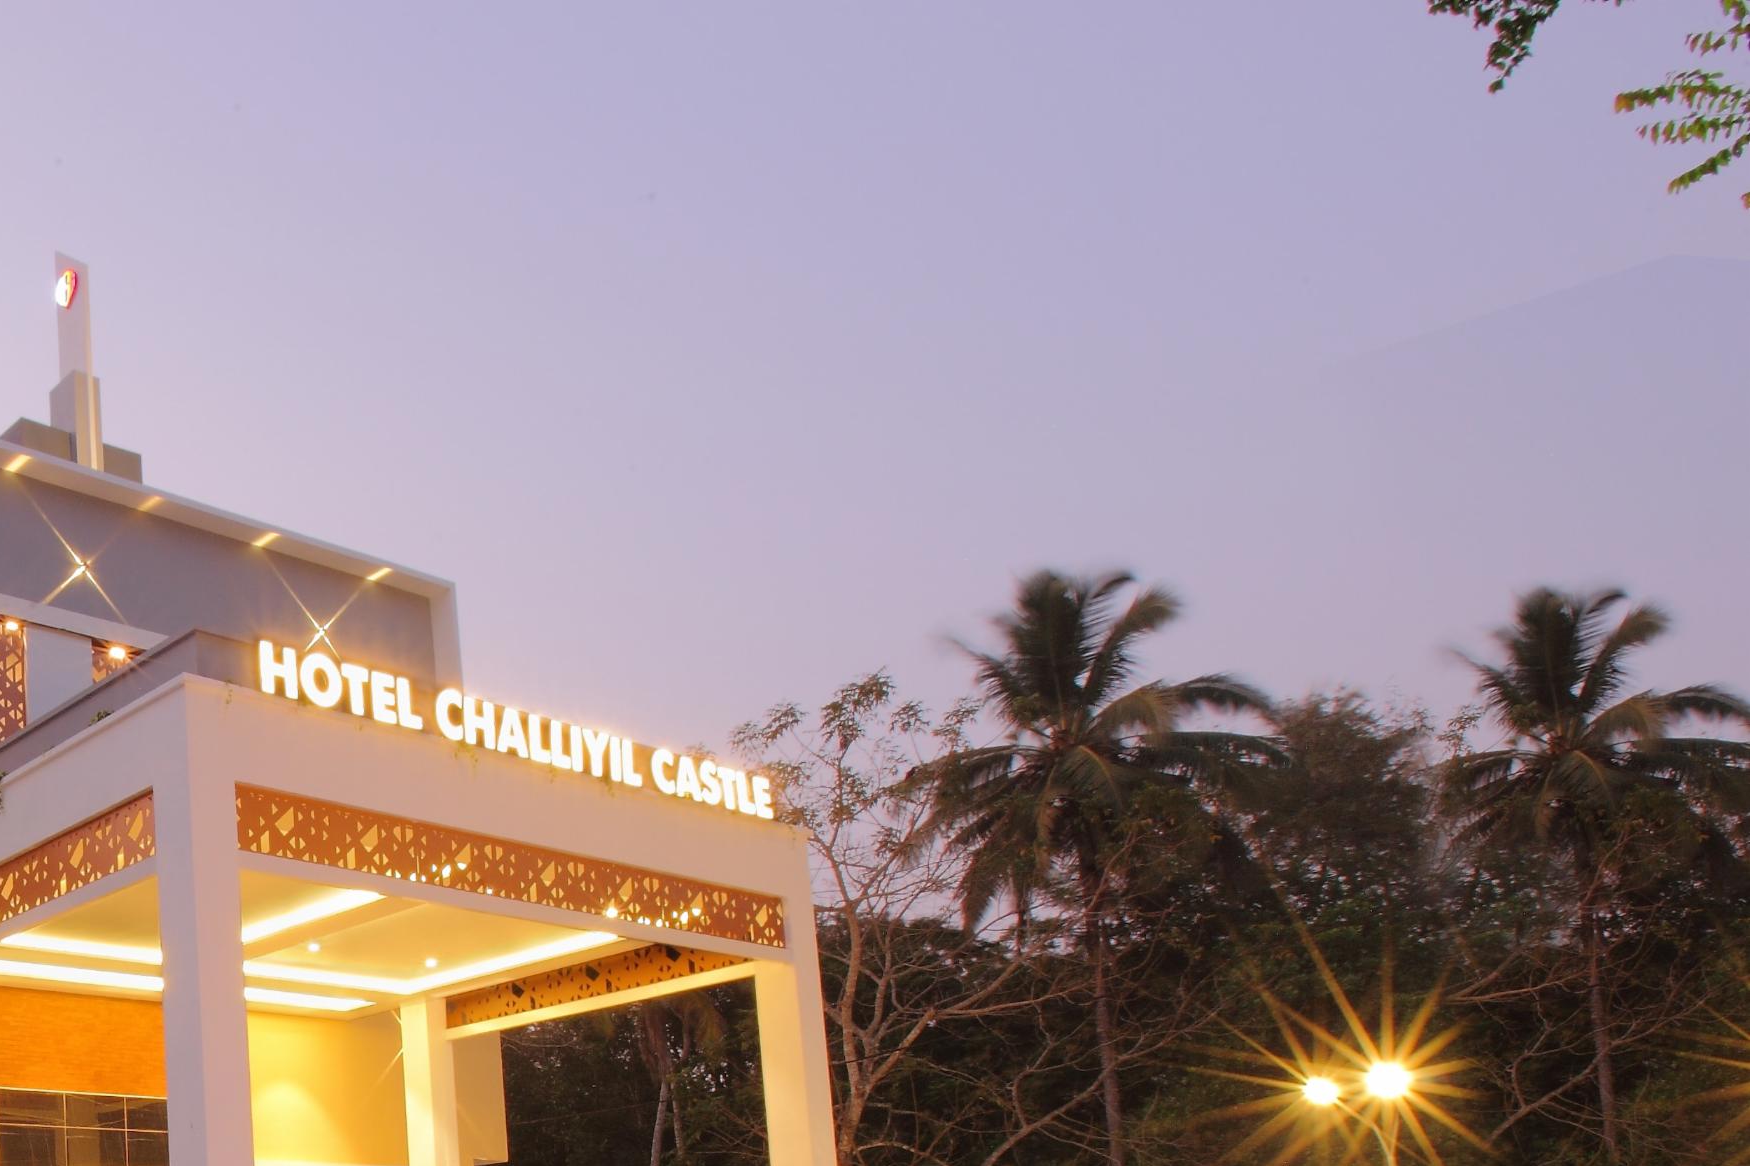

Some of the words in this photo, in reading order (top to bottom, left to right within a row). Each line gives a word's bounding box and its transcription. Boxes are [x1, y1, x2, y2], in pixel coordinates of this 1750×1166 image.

[258, 640, 424, 731] HOTEL
[435, 687, 644, 788] CHALLIYIL
[651, 747, 774, 820] CASTLE
